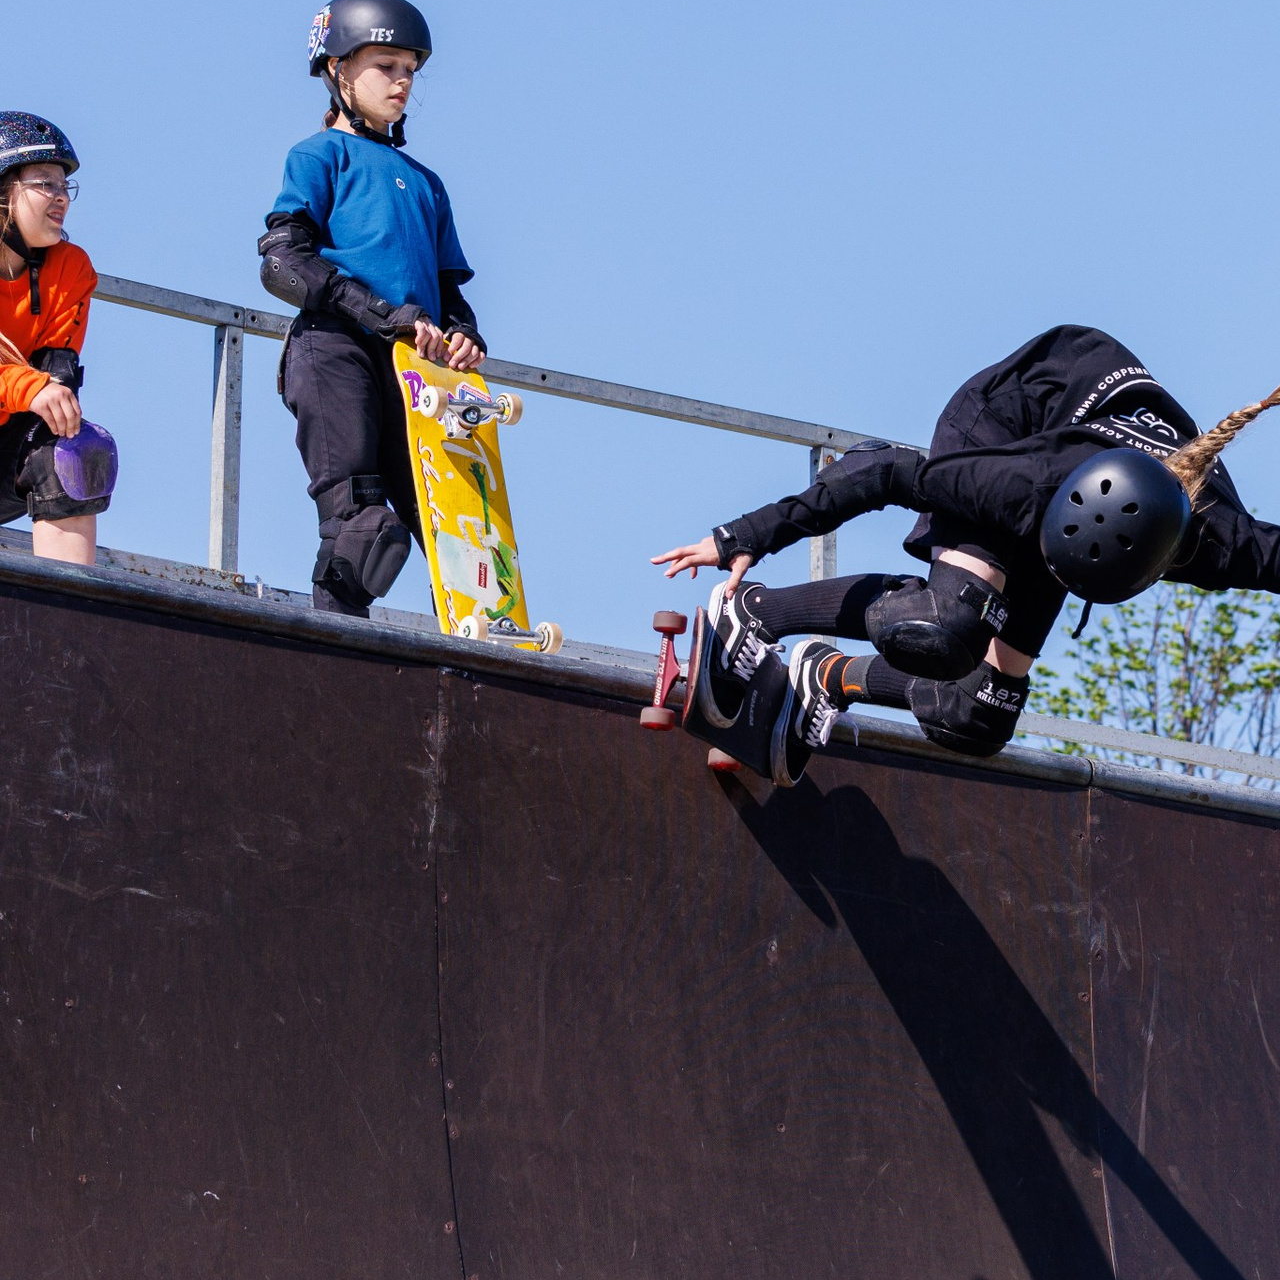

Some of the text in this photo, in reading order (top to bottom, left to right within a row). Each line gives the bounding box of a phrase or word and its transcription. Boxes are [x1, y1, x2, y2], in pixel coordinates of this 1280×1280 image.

[1126, 438, 1169, 457] SPORT
[658, 662, 665, 675] TO
[654, 676, 663, 705] GRIND
[976, 690, 1001, 707] KILLER
[983, 682, 1020, 704] 187
